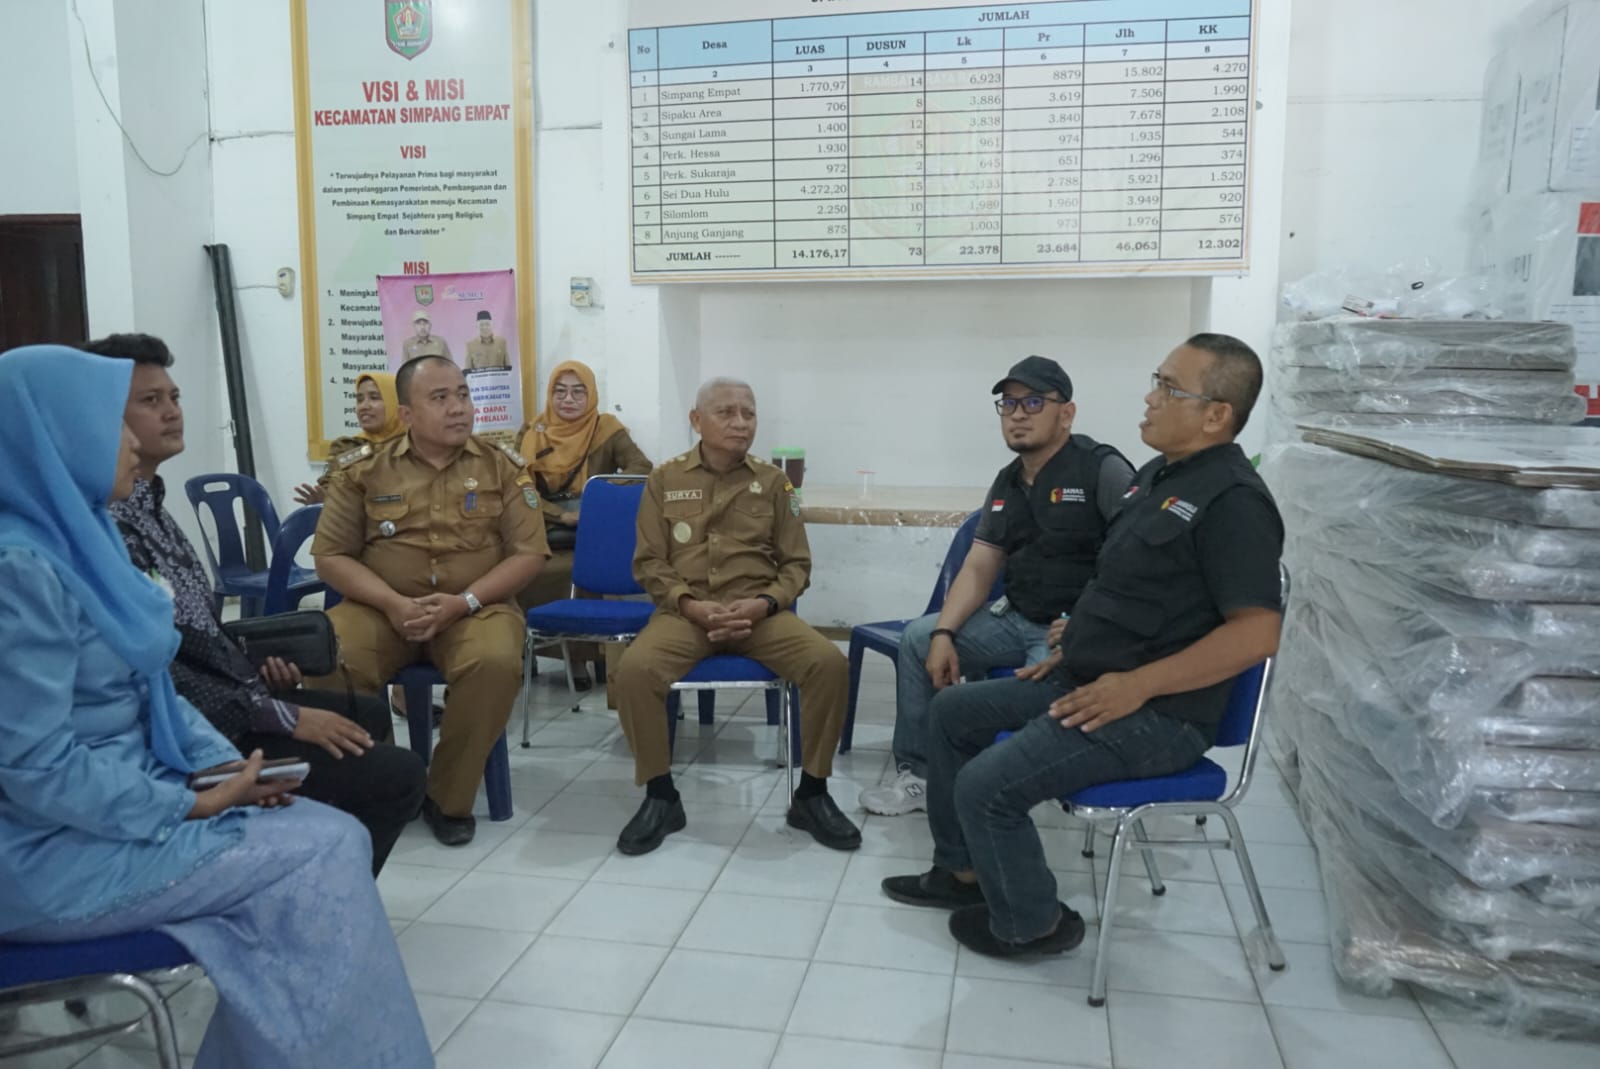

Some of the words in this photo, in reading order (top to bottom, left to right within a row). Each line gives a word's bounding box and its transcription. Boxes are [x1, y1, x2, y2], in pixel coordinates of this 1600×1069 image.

[978, 10, 1030, 22] JUMLAH
[795, 45, 825, 55] LUAS
[866, 40, 907, 51] DUSUN
[956, 36, 971, 47] Lk
[1038, 32, 1051, 43] Pr
[1116, 27, 1135, 39] Jlh
[1199, 24, 1218, 35] KK
[637, 46, 650, 54] No
[702, 40, 727, 50] Desa
[1122, 49, 1127, 57] 7
[661, 90, 704, 100] Simpang
[707, 87, 741, 98] Empat
[800, 81, 846, 92] 1.770,97
[911, 77, 922, 87] 14
[1053, 70, 1081, 80] 8879
[1124, 66, 1163, 77] 15.802
[1213, 62, 1246, 73] 4.270
[362, 81, 399, 103] VISI
[406, 80, 419, 101] &
[426, 79, 465, 100] MISI
[642, 113, 648, 121] 2
[662, 111, 696, 122] Sipaku
[699, 109, 722, 118] Area
[826, 102, 846, 112] 706
[916, 99, 923, 108] 8
[969, 96, 1001, 105] 3.886
[1048, 91, 1081, 102] 3.619
[1130, 88, 1163, 99] 7.506
[1213, 84, 1246, 95] 1.990
[314, 110, 396, 126] KECAMATAN
[400, 106, 461, 123] SIMPANG
[465, 104, 510, 121] EMPAT
[643, 133, 649, 141] 3
[662, 130, 696, 141] Sungai
[699, 129, 727, 138] Lama
[817, 123, 847, 133] 1.400
[910, 119, 923, 129] 12
[969, 116, 1000, 126] 3.838
[1048, 112, 1081, 123] 3.840
[1129, 109, 1162, 120] 7.678
[1211, 106, 1245, 116] 2.108
[643, 152, 649, 160] 4
[662, 151, 686, 160] Perk.
[690, 149, 720, 159] Hessa
[817, 143, 847, 153] 1.930
[979, 137, 1000, 148] 961
[1058, 134, 1080, 145] 974
[1129, 131, 1161, 142] 1.935
[1222, 127, 1244, 138] 544
[400, 145, 426, 159] VISI
[644, 172, 650, 180] 5
[663, 171, 687, 180] Perk.
[690, 169, 736, 179] Sukaraja
[826, 164, 847, 173] 972
[916, 161, 923, 171] 2
[1058, 155, 1079, 166] 651
[1129, 152, 1161, 163] 1.296
[1221, 149, 1243, 160] 374
[336, 171, 379, 180] Terwujudnya
[380, 170, 416, 179] Pelayanan
[418, 170, 437, 178] Prima
[440, 170, 454, 178] bagi
[456, 170, 497, 178] masyarakat
[400, 184, 441, 193] Pemerintah,
[443, 183, 492, 192] Pembangunan
[494, 183, 507, 191] dan
[644, 192, 650, 200] 6
[663, 190, 677, 199] Sei
[680, 190, 701, 199] Dua
[704, 188, 729, 198] Hulu
[800, 184, 847, 195] 4.272,20
[910, 182, 923, 192] 15
[1047, 176, 1079, 187] 2.788
[1128, 173, 1159, 184] 5.921
[1210, 170, 1242, 181] 1.520
[332, 199, 369, 207] Pembinaan
[430, 199, 456, 207] menuju
[458, 197, 497, 205] Kecamatan
[644, 211, 650, 220] 7
[663, 209, 708, 219] Silomlom
[817, 204, 847, 215] 2.250
[1127, 195, 1159, 205] 3.949
[1219, 192, 1242, 203] 920
[346, 212, 375, 221] Simpang
[377, 212, 399, 220] Empat
[402, 211, 435, 220] Sejahtera
[437, 212, 454, 220] yang
[456, 211, 483, 220] Religius
[385, 228, 397, 236] dan
[399, 227, 440, 236] Berkarakter
[645, 231, 651, 239] 8
[664, 230, 699, 240] Anjung
[702, 228, 744, 239] Ganjang
[827, 224, 847, 234] 875
[916, 223, 922, 233] 7
[970, 221, 1000, 231] 1.003
[1127, 216, 1159, 227] 1.976
[1219, 213, 1241, 224] 576
[666, 252, 711, 261] JUMLAH
[792, 249, 847, 260] 14.176,17
[909, 247, 922, 257] 73
[960, 245, 1000, 255] 22.378
[1037, 243, 1077, 253] 23.684
[1116, 240, 1157, 251] 46.063
[1198, 239, 1240, 249] 12.302
[403, 262, 429, 274] MISI
[340, 289, 378, 298] Meningkat
[341, 319, 382, 328] Mewujudka
[341, 333, 384, 342] Masyarakat
[342, 362, 385, 371] Masyarakat
[666, 491, 698, 500] SURYA
